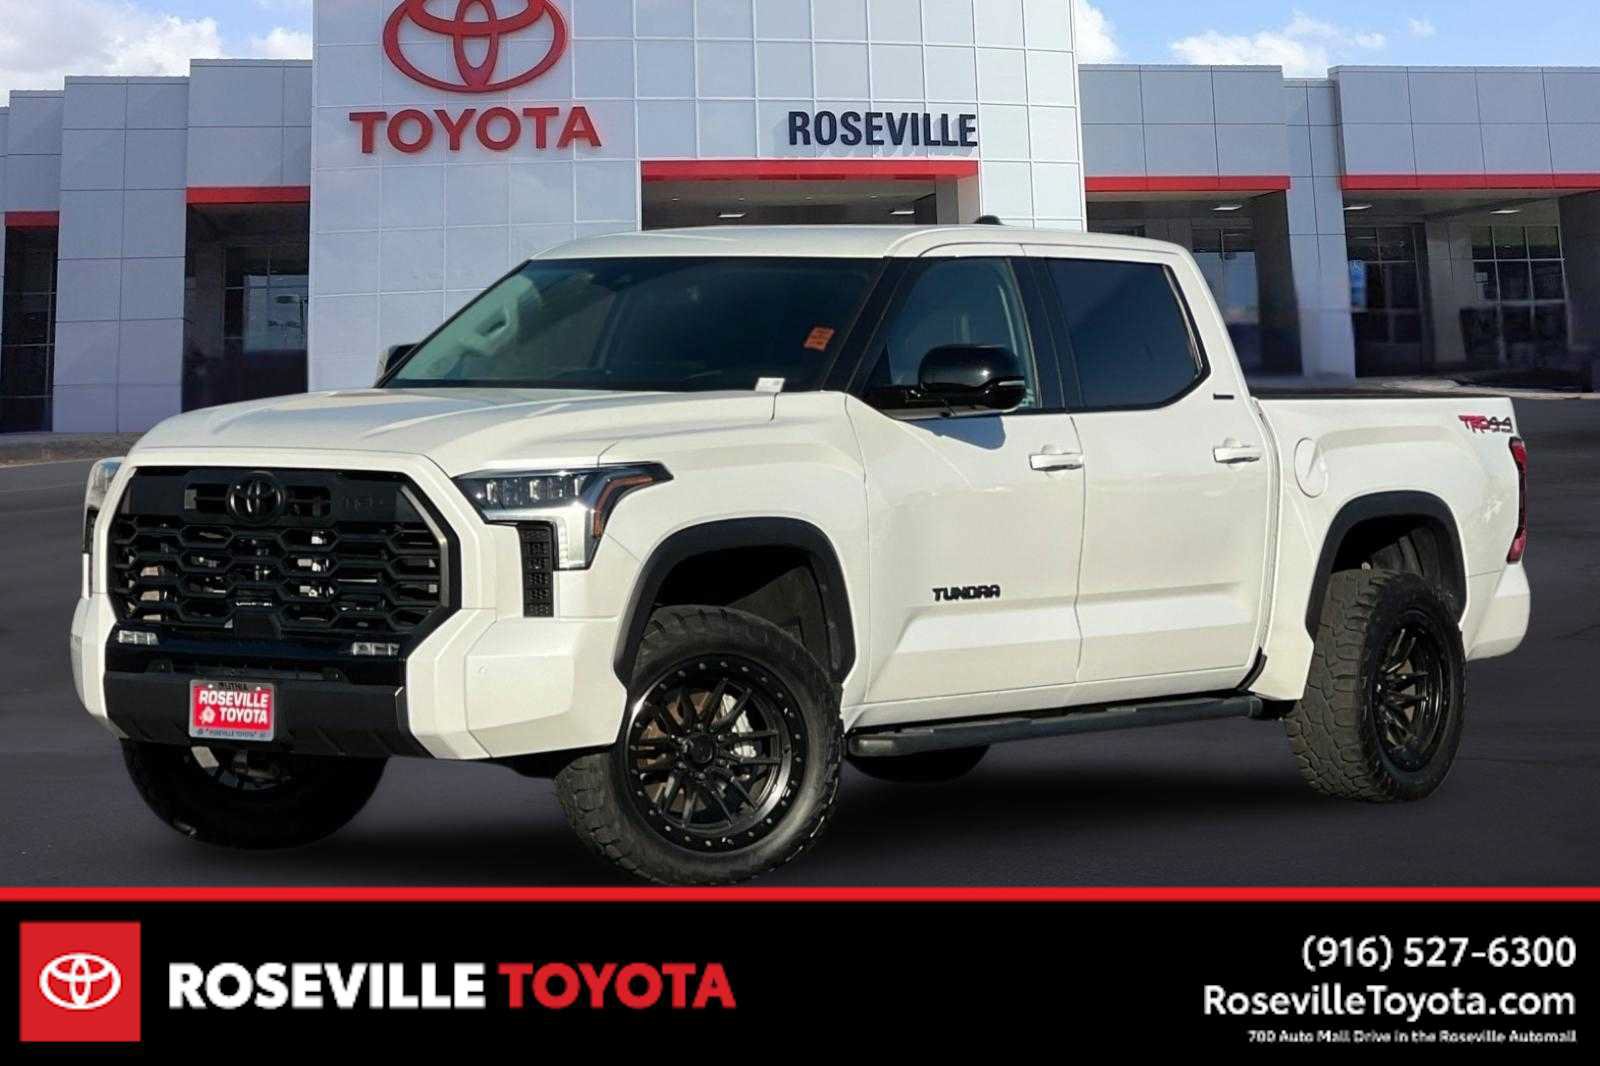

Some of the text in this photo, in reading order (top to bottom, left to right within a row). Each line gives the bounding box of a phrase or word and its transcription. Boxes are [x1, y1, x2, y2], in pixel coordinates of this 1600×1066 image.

[349, 106, 602, 154] TOYOTA
[788, 111, 978, 148] ROSEVILLE
[932, 584, 1001, 602] TUNDRA
[198, 690, 269, 708] ROSEVILLE
[219, 706, 268, 725] TOYOTA
